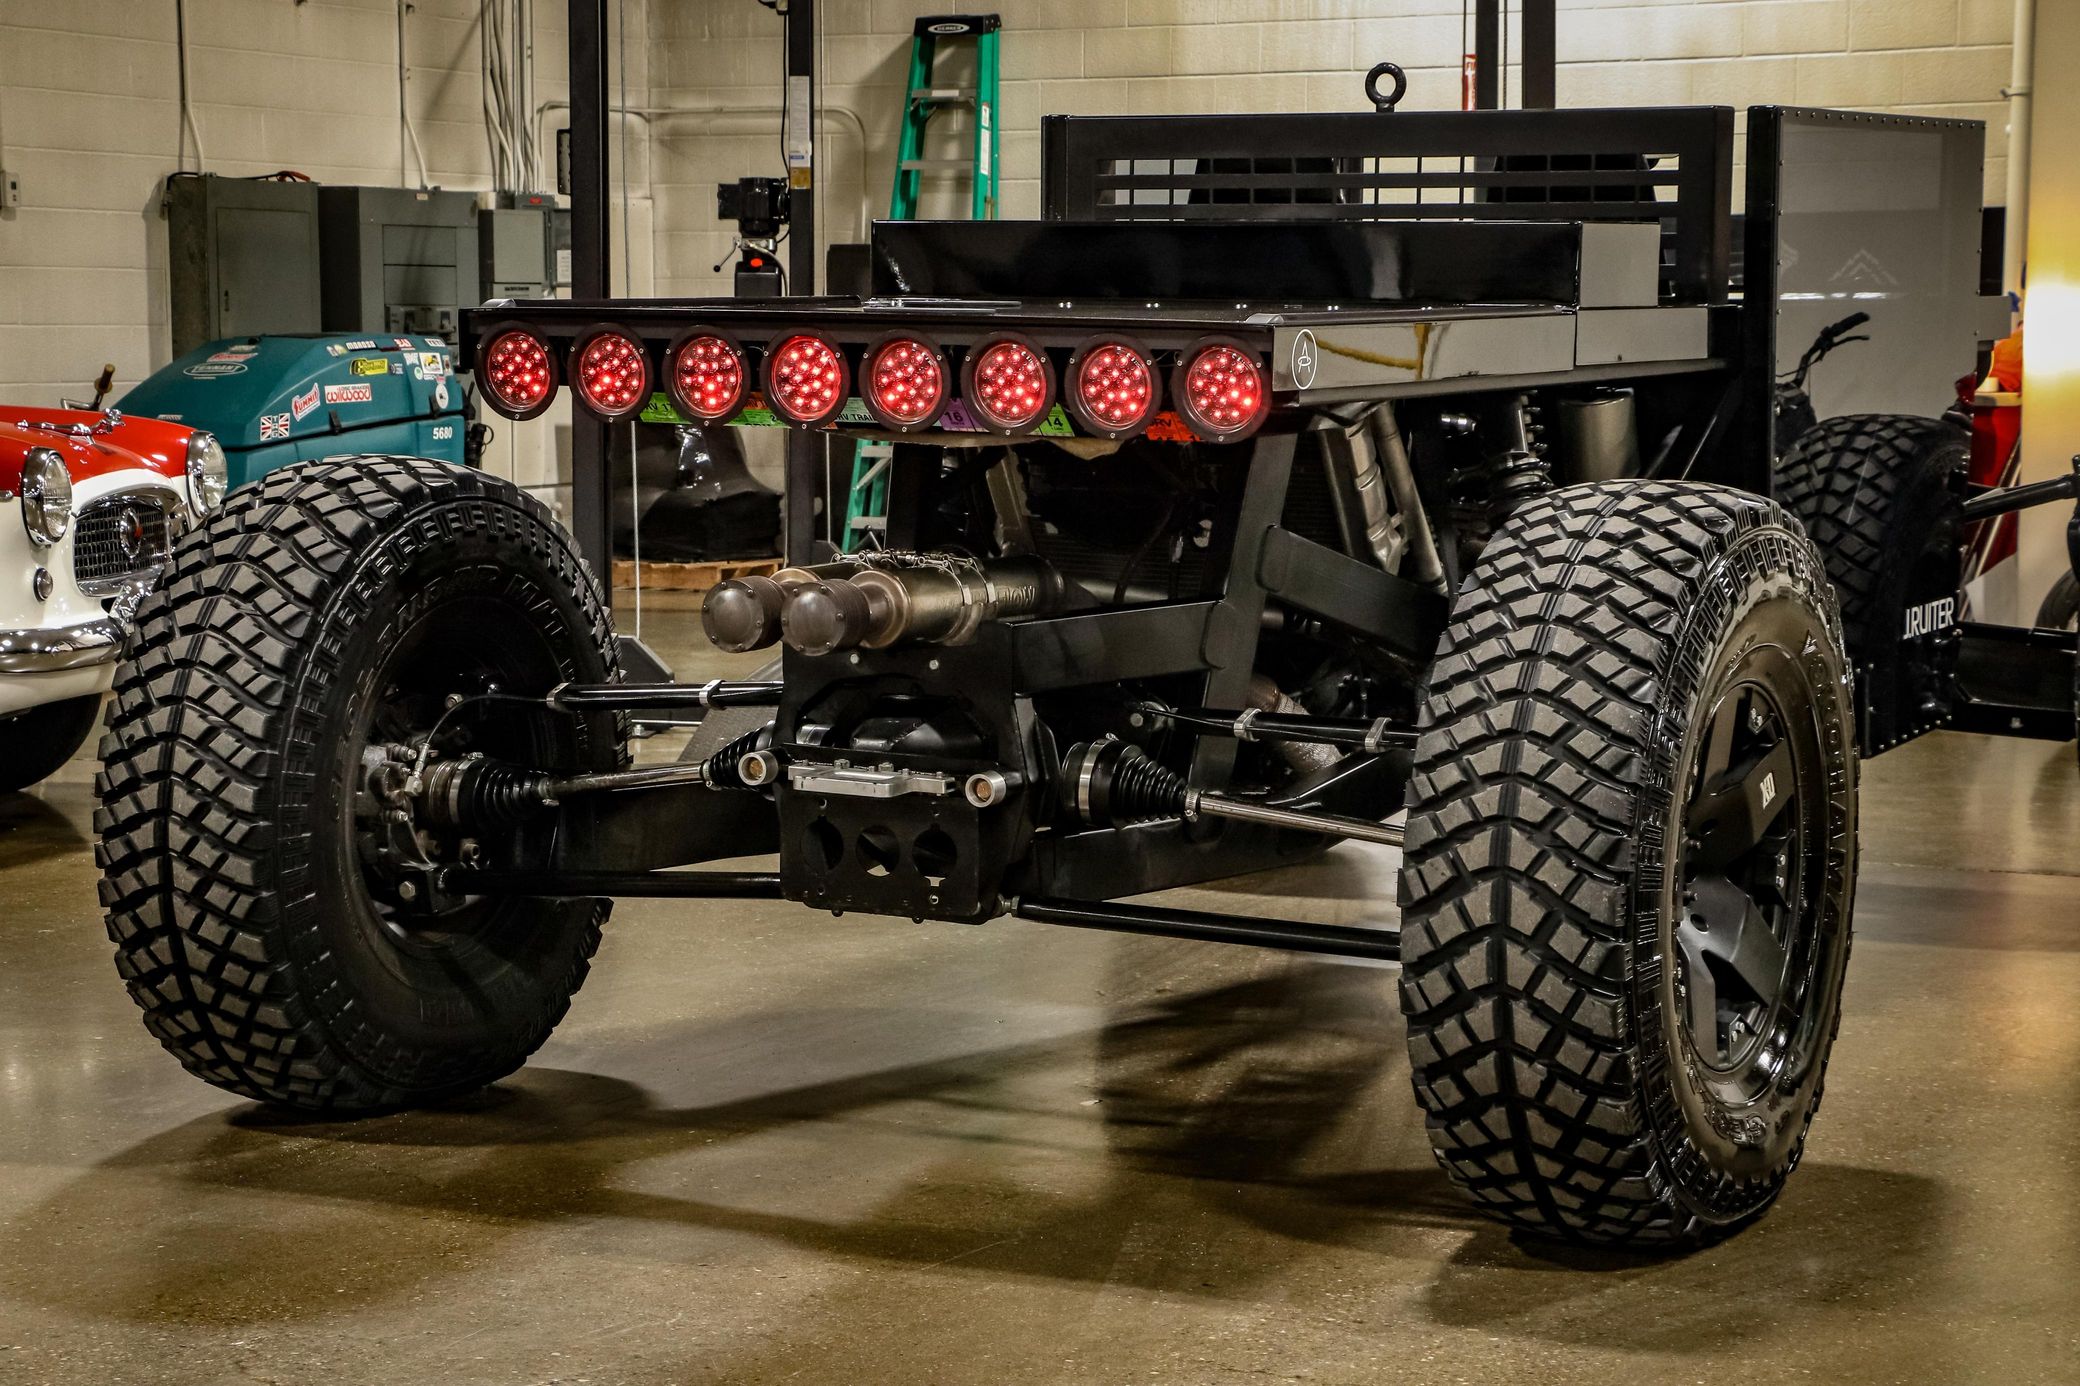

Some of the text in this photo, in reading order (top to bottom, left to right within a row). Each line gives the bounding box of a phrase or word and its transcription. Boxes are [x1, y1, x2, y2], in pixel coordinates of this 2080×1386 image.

[327, 386, 371, 402] wilwood
[851, 413, 875, 421] TRAI
[944, 411, 963, 421] 16
[432, 426, 453, 440] 5680
[1803, 628, 1848, 937] YOKOHAMA
